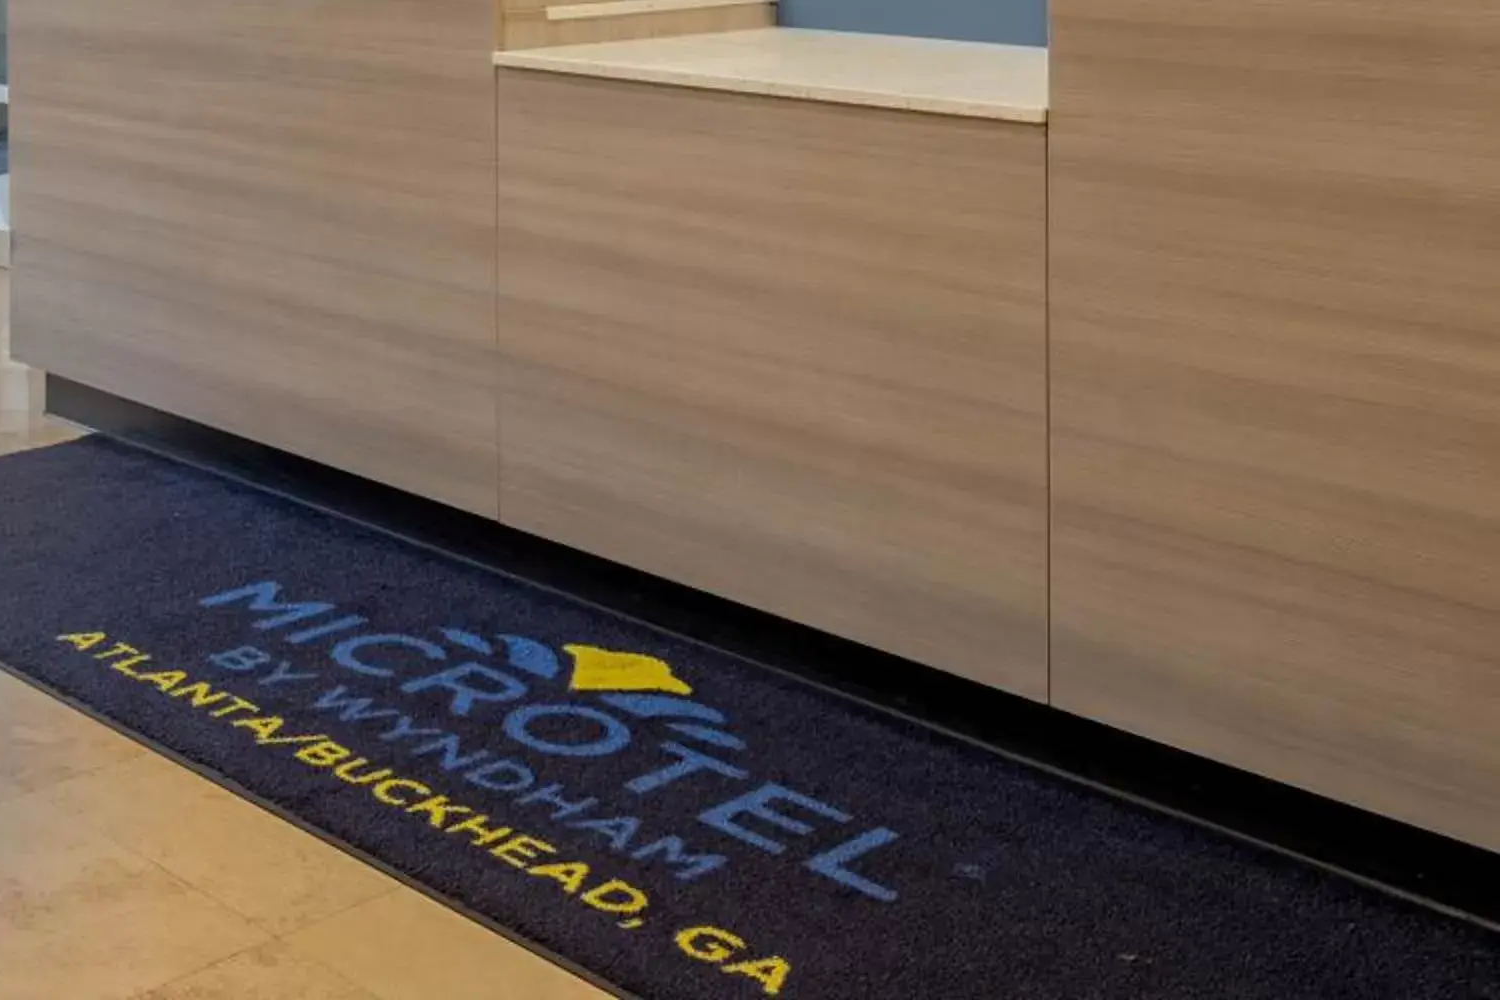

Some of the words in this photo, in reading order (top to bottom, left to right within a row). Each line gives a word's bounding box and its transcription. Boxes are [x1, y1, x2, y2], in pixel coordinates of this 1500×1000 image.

[56, 630, 649, 930] ATLANTA/BUCKHEAD,
[674, 924, 792, 995] GA
[198, 579, 900, 902] MICROTEL
[209, 645, 316, 691] BY
[316, 684, 729, 880] WYNDHAM
